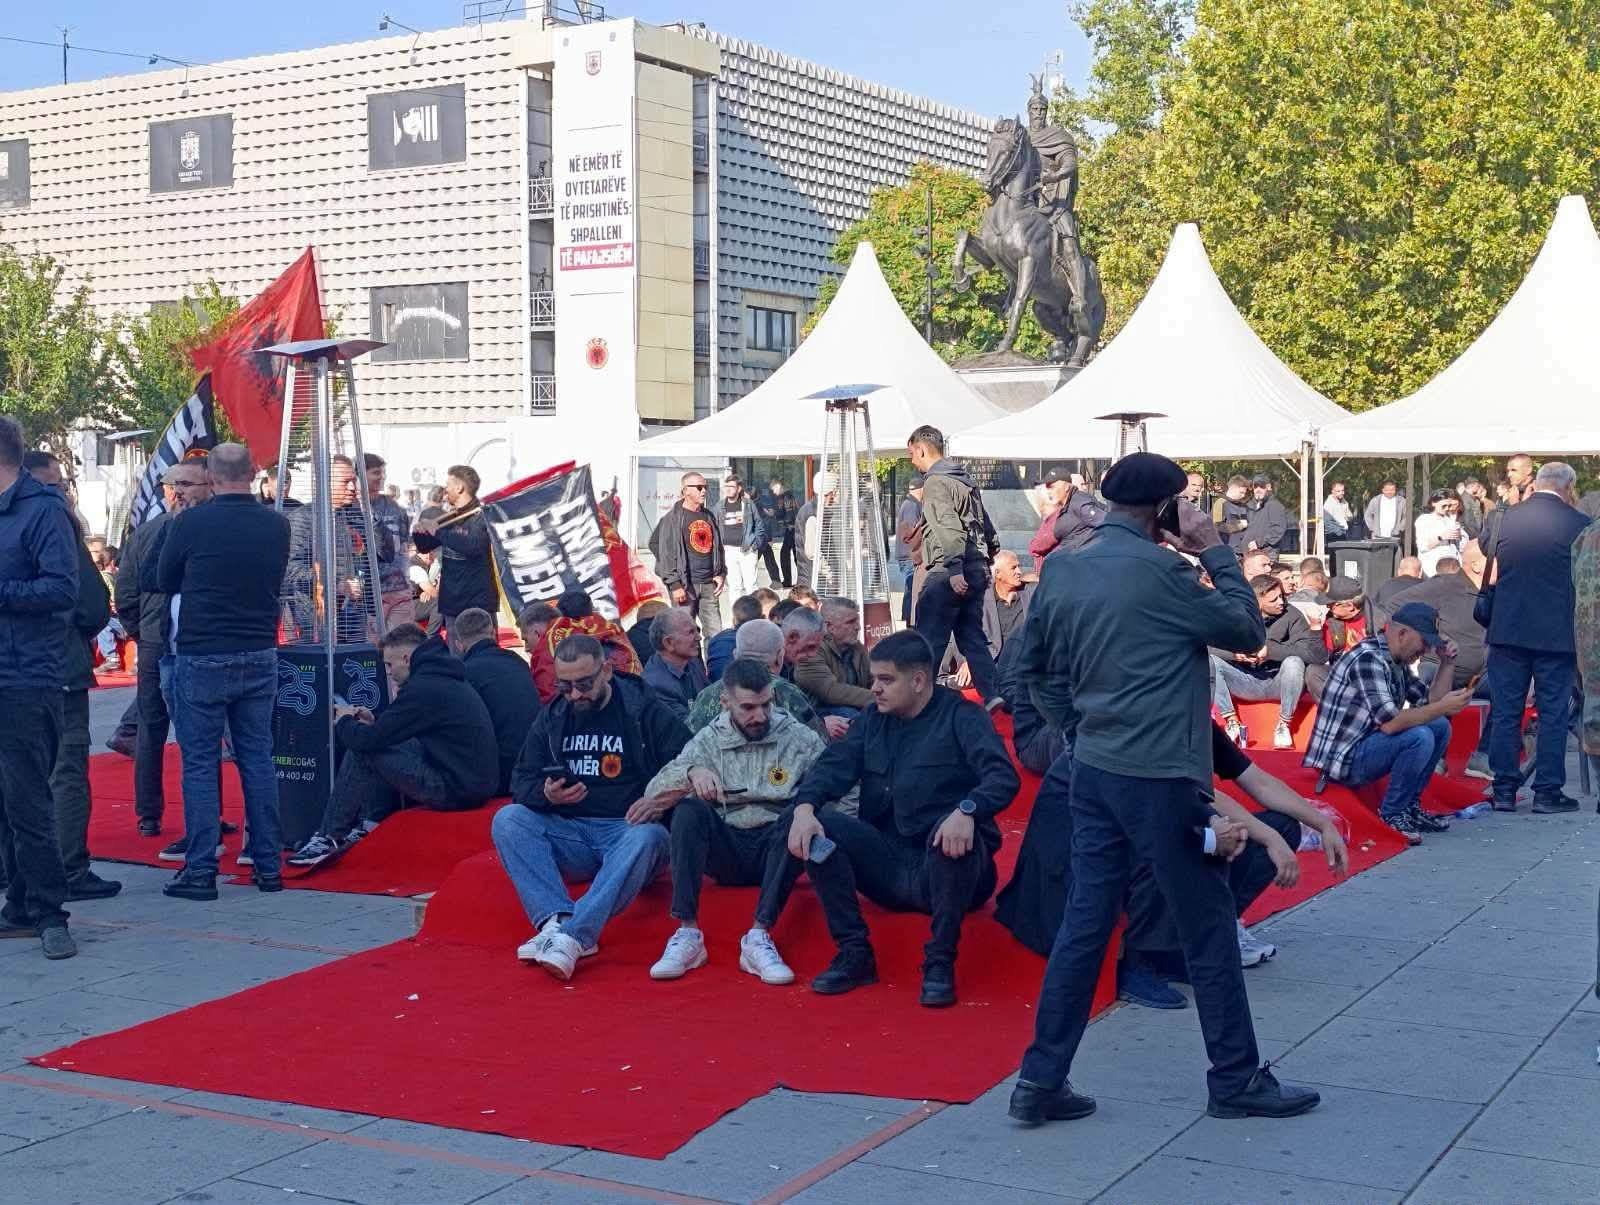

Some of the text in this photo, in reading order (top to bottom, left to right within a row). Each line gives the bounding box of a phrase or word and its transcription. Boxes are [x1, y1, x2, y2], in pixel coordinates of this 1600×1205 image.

[569, 150, 623, 173] NË EMËR TË
[560, 201, 571, 220] TË
[570, 225, 622, 243] SHPALLENI
[560, 247, 574, 268] TË
[551, 495, 610, 584] LIRIA
[491, 513, 567, 603] EMËR
[562, 734, 624, 753] LIRIA KA
[567, 755, 600, 776] MËR
